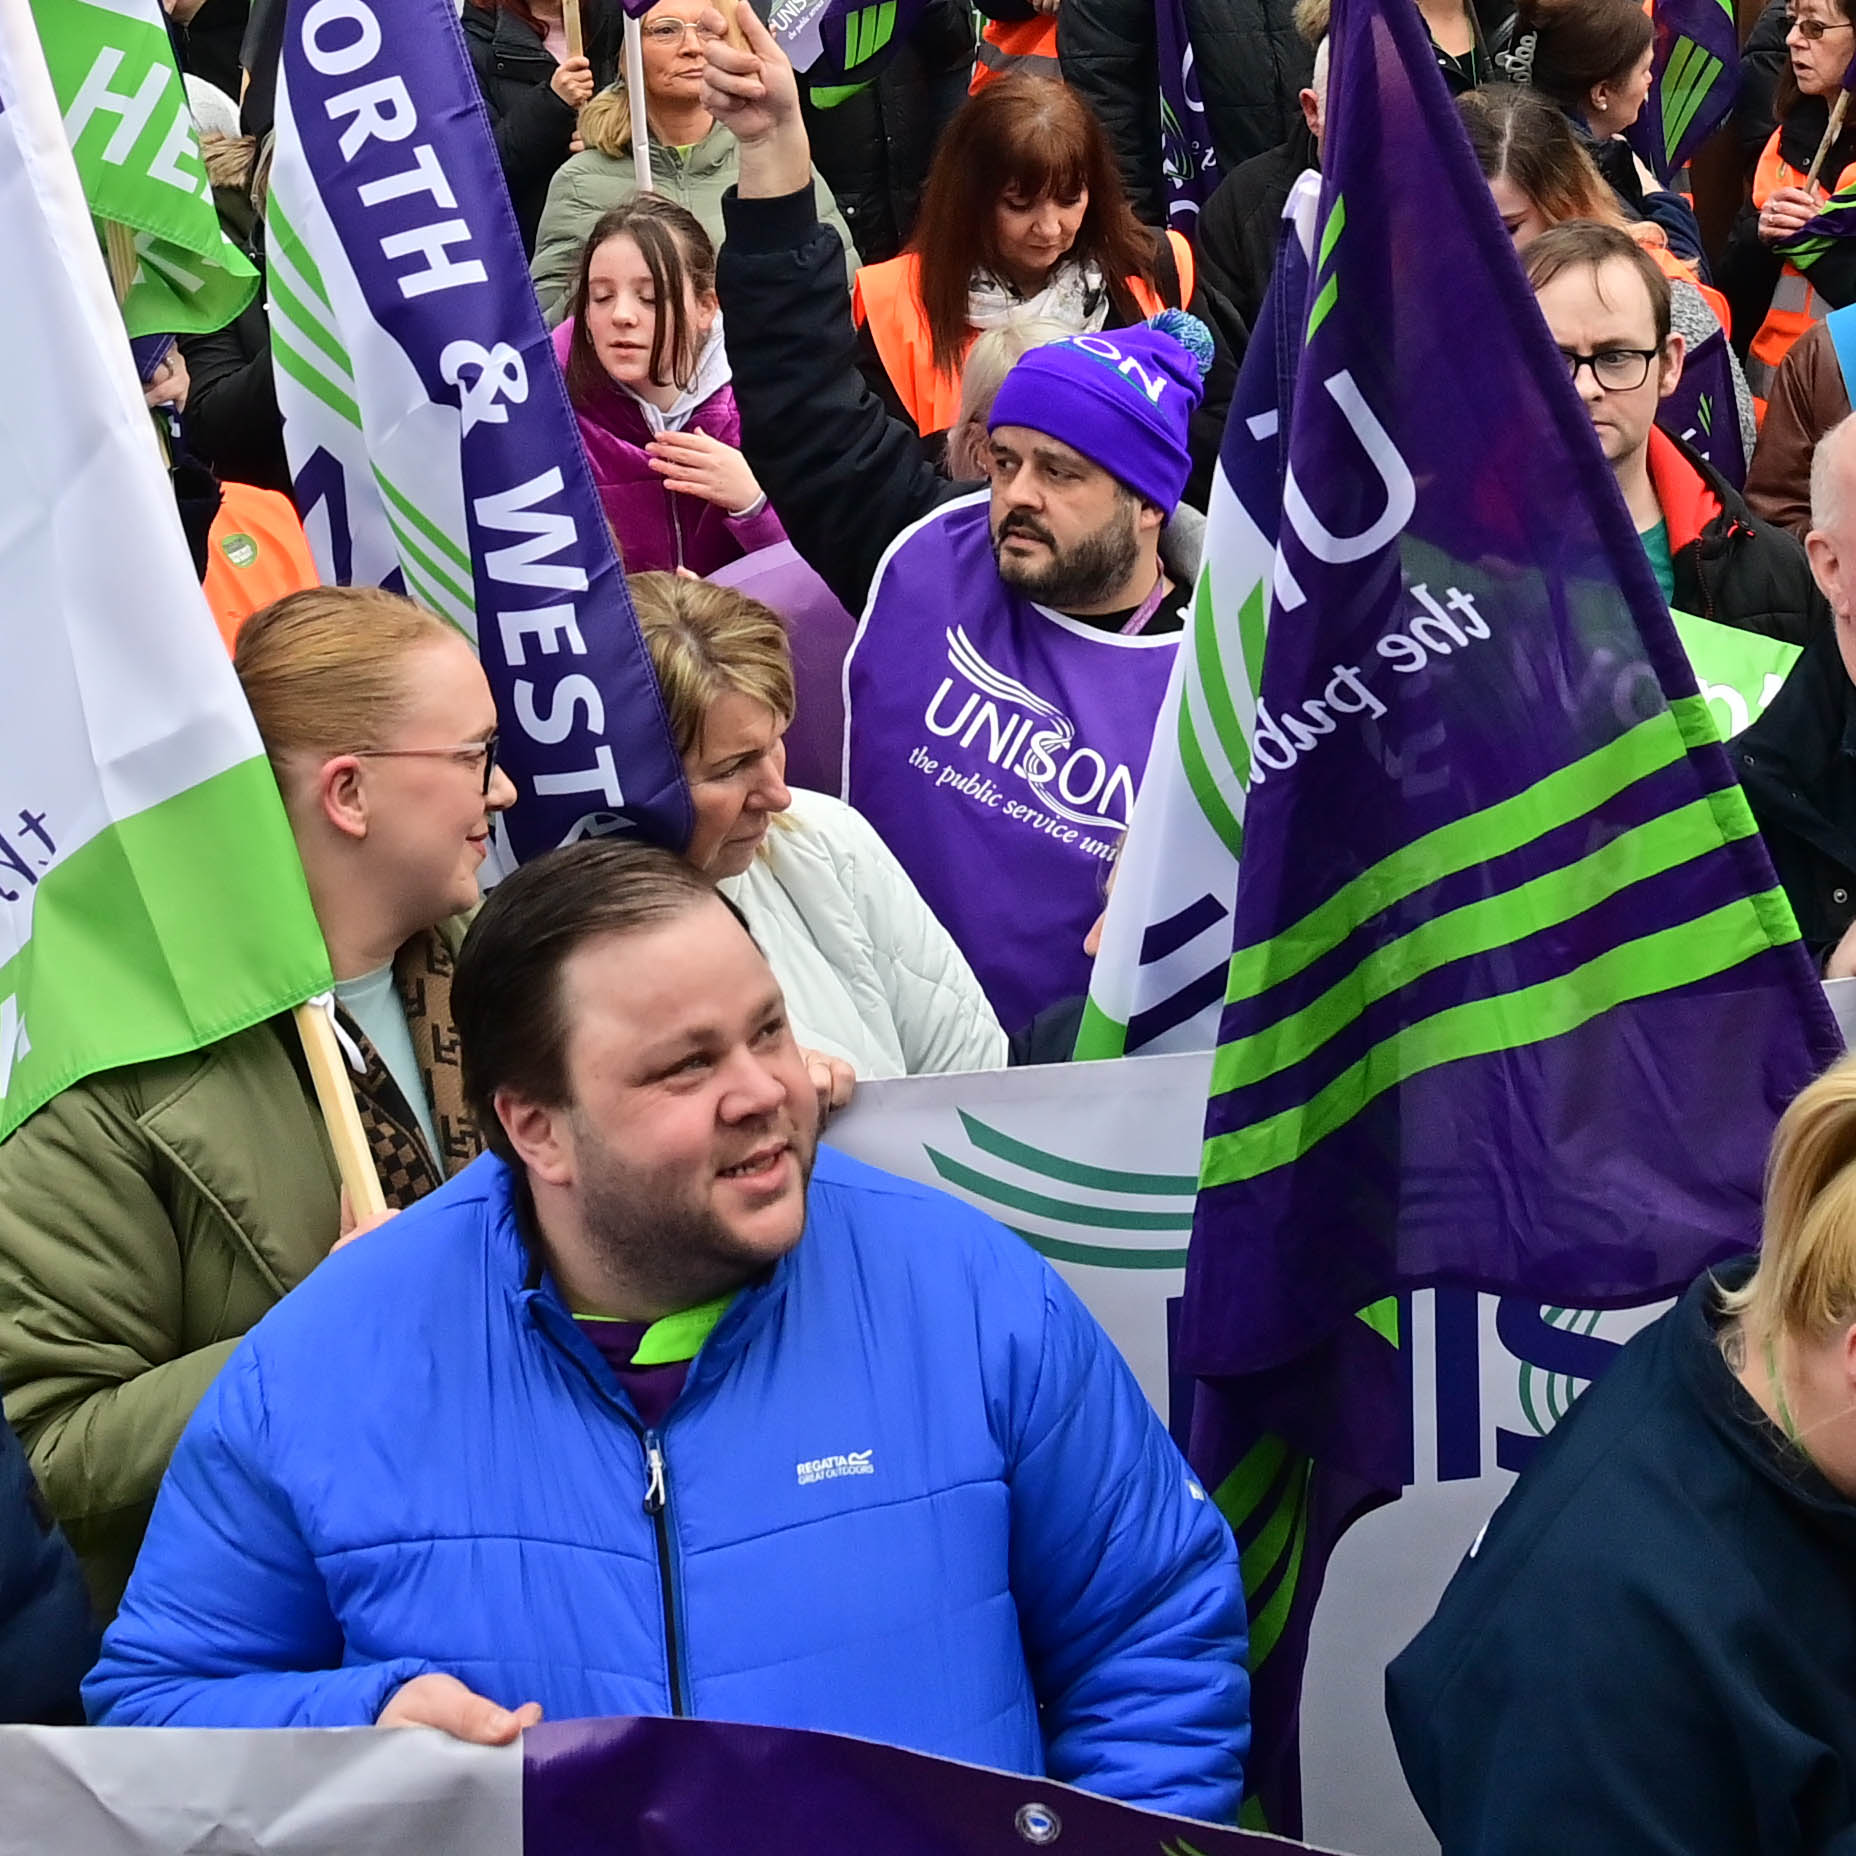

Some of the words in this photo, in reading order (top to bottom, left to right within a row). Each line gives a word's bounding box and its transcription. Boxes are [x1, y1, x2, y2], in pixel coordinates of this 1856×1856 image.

[439, 340, 529, 439] &
[474, 464, 625, 831] WEST
[909, 744, 938, 770] the
[938, 764, 1004, 810] public
[1003, 794, 1080, 846] service
[1079, 830, 1119, 862] uni
[924, 676, 1133, 826] UNISON
[797, 1456, 847, 1476] REGATTA
[797, 1470, 826, 1486] GREAT
[825, 1463, 875, 1480] OUTDOORS
